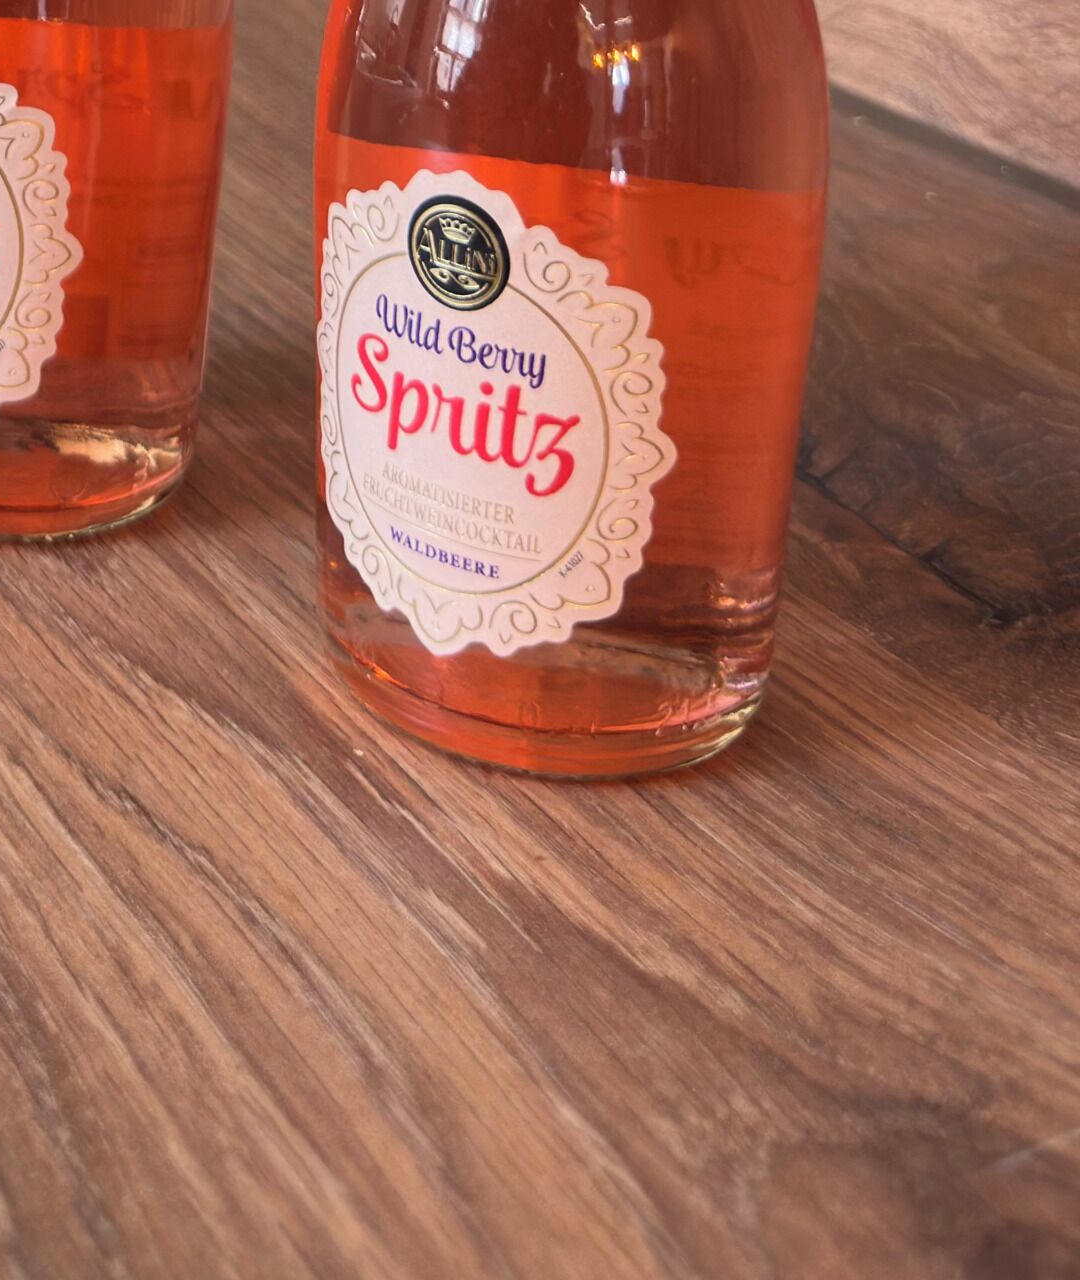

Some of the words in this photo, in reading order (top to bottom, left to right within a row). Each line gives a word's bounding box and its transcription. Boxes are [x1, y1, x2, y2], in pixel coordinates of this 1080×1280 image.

[376, 293, 443, 354] Wild
[447, 327, 547, 388] Berry
[350, 332, 582, 497] Spritz
[363, 472, 542, 555] FRUCHTWEINCOCKTAIL
[382, 463, 514, 524] AROMATISIERTER
[389, 525, 500, 579] WALDBEERE
